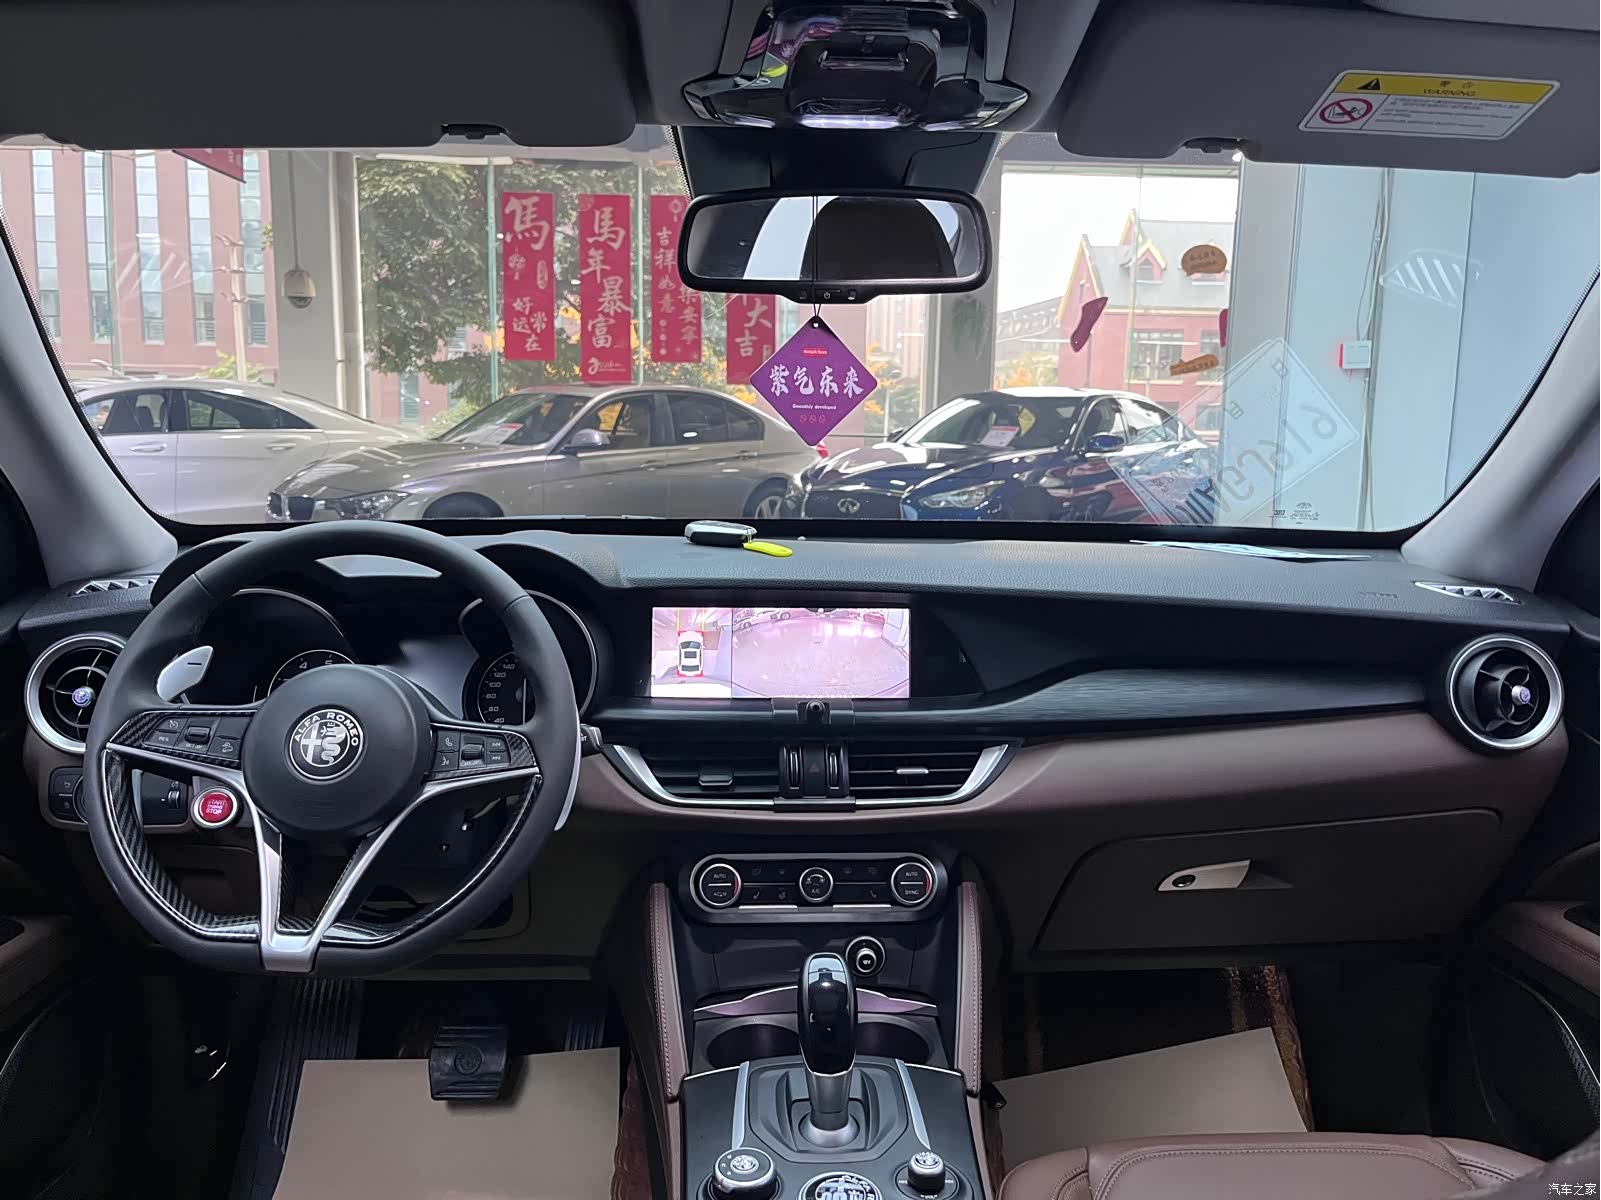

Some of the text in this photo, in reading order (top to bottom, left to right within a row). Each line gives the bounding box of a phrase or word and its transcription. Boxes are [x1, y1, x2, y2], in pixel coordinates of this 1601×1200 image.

[769, 363, 865, 399] 紫气东来
[294, 712, 360, 747] ALFA ROMEO
